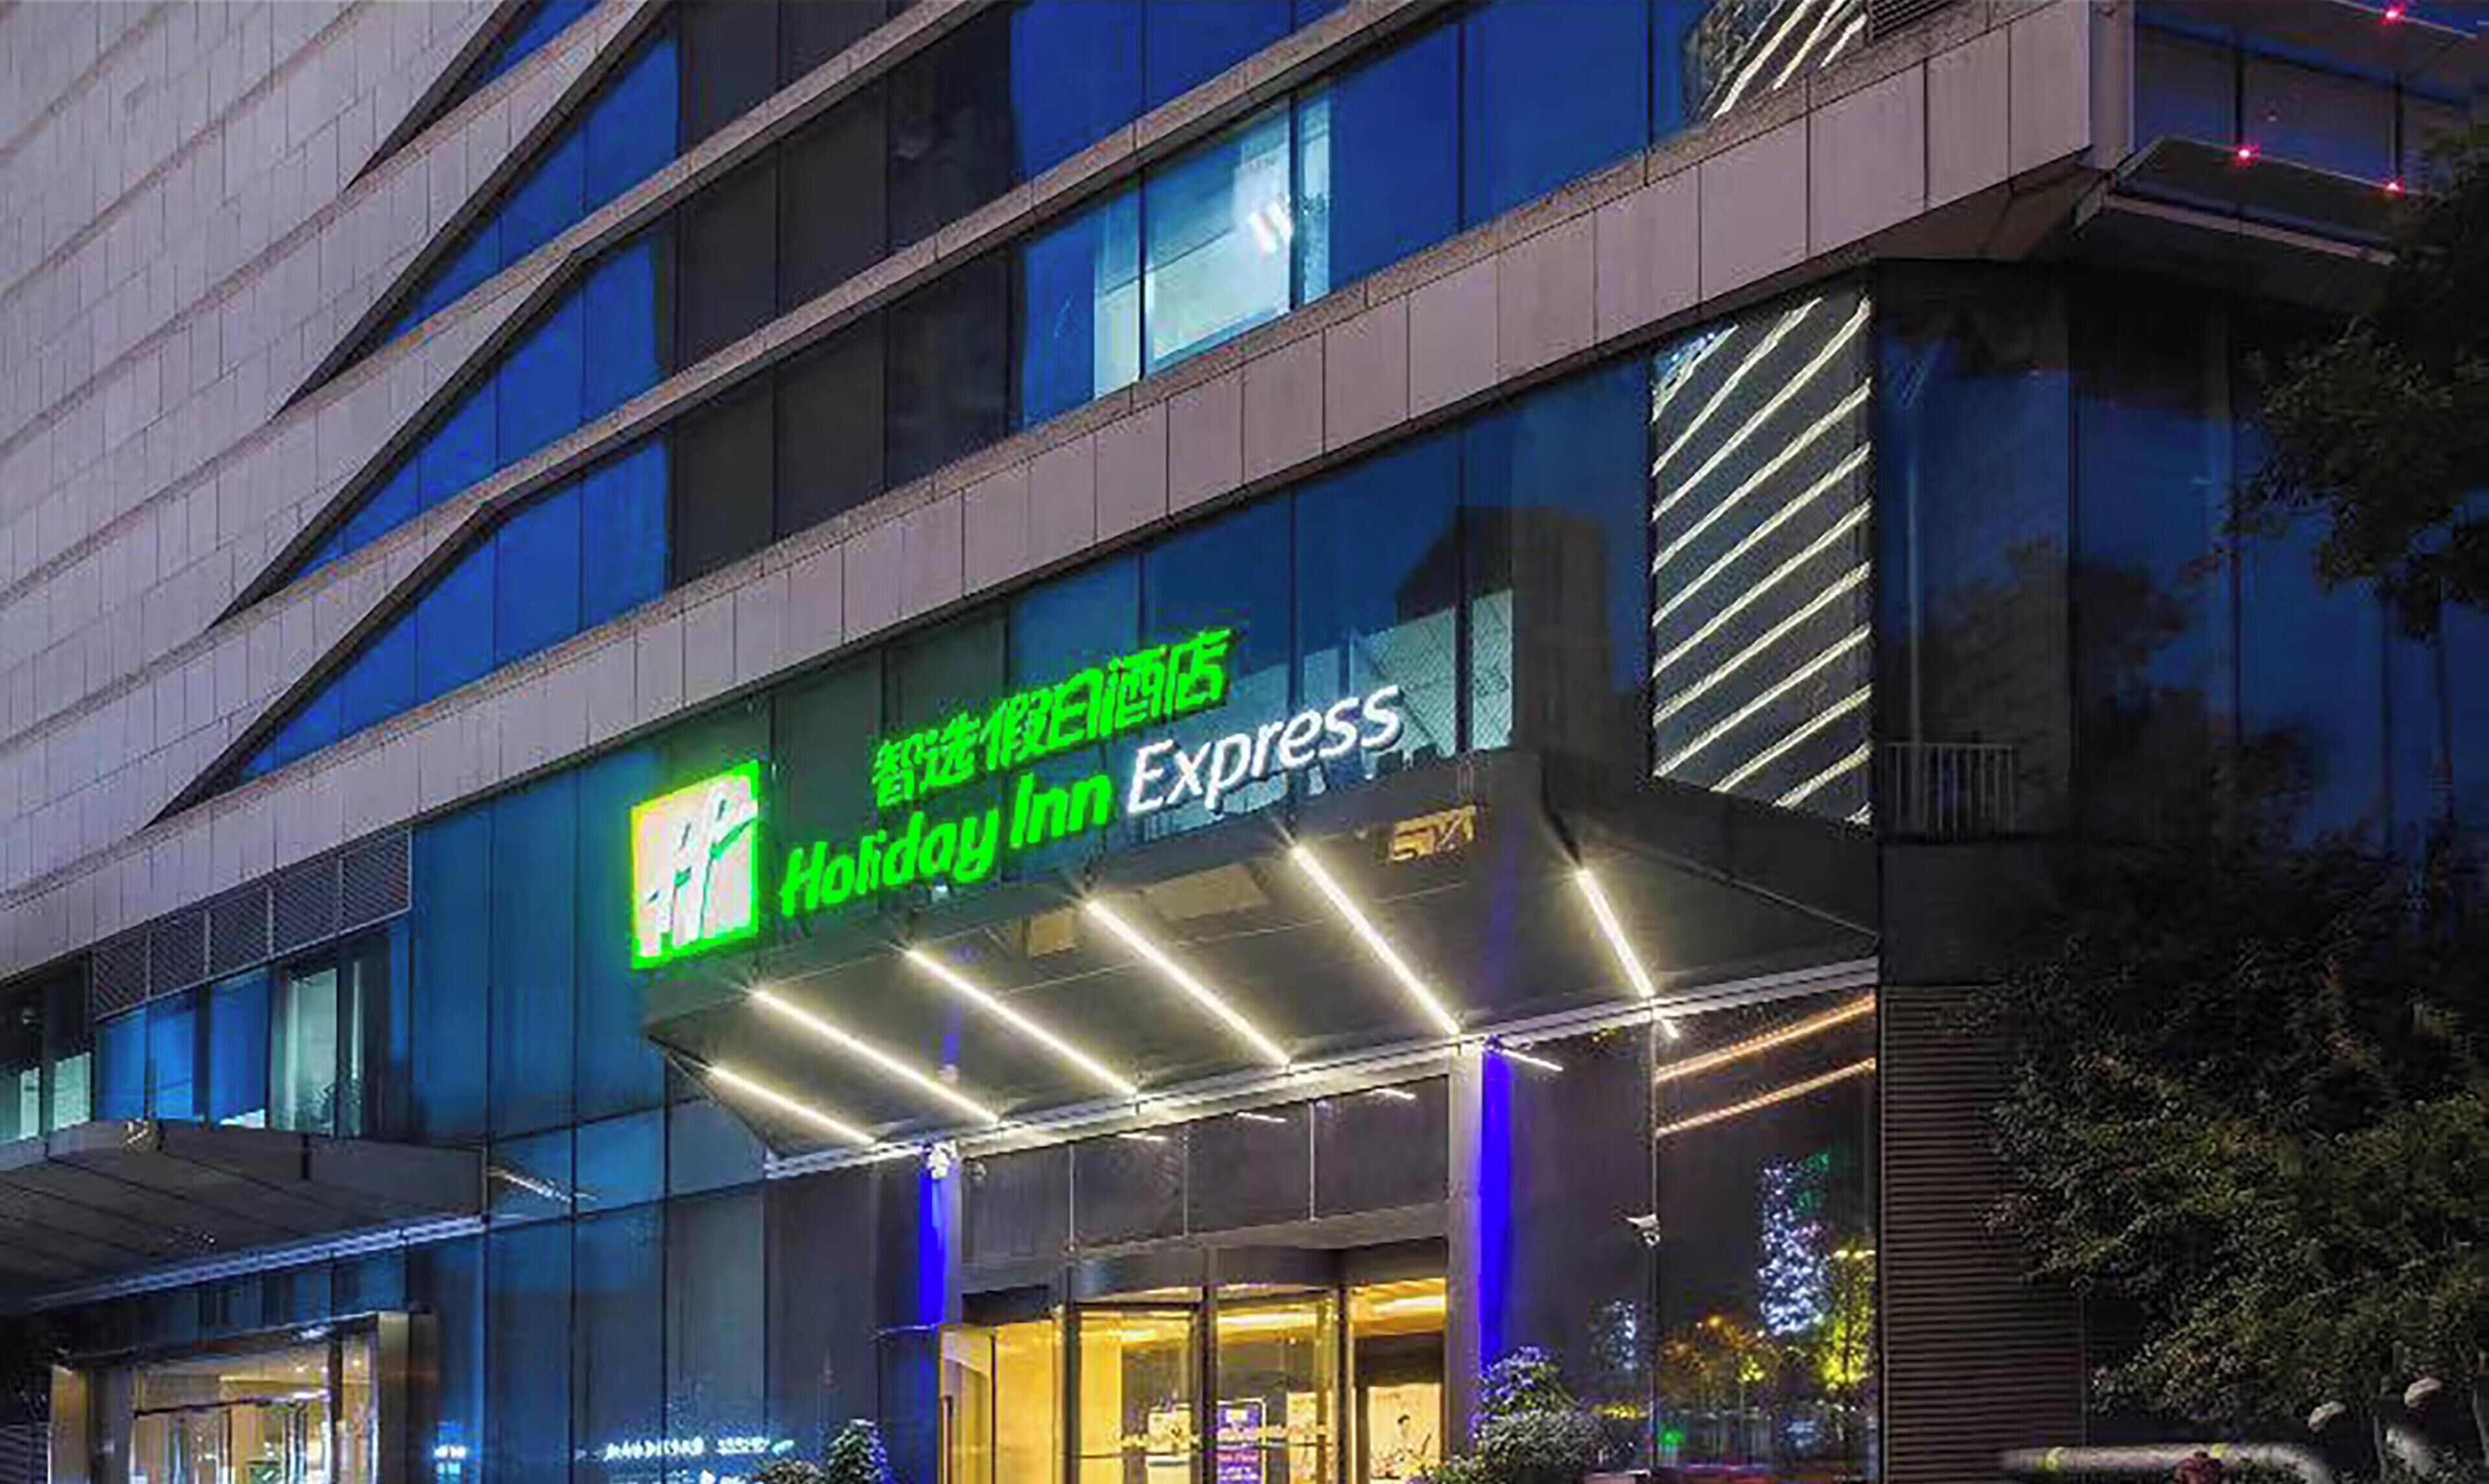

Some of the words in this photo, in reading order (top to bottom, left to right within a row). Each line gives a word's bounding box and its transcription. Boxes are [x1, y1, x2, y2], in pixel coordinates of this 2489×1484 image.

[780, 809, 999, 916] Holiday
[1009, 773, 1111, 848] Inn
[1128, 684, 1401, 813] Express
[872, 628, 1231, 807] 智选假日酒店
